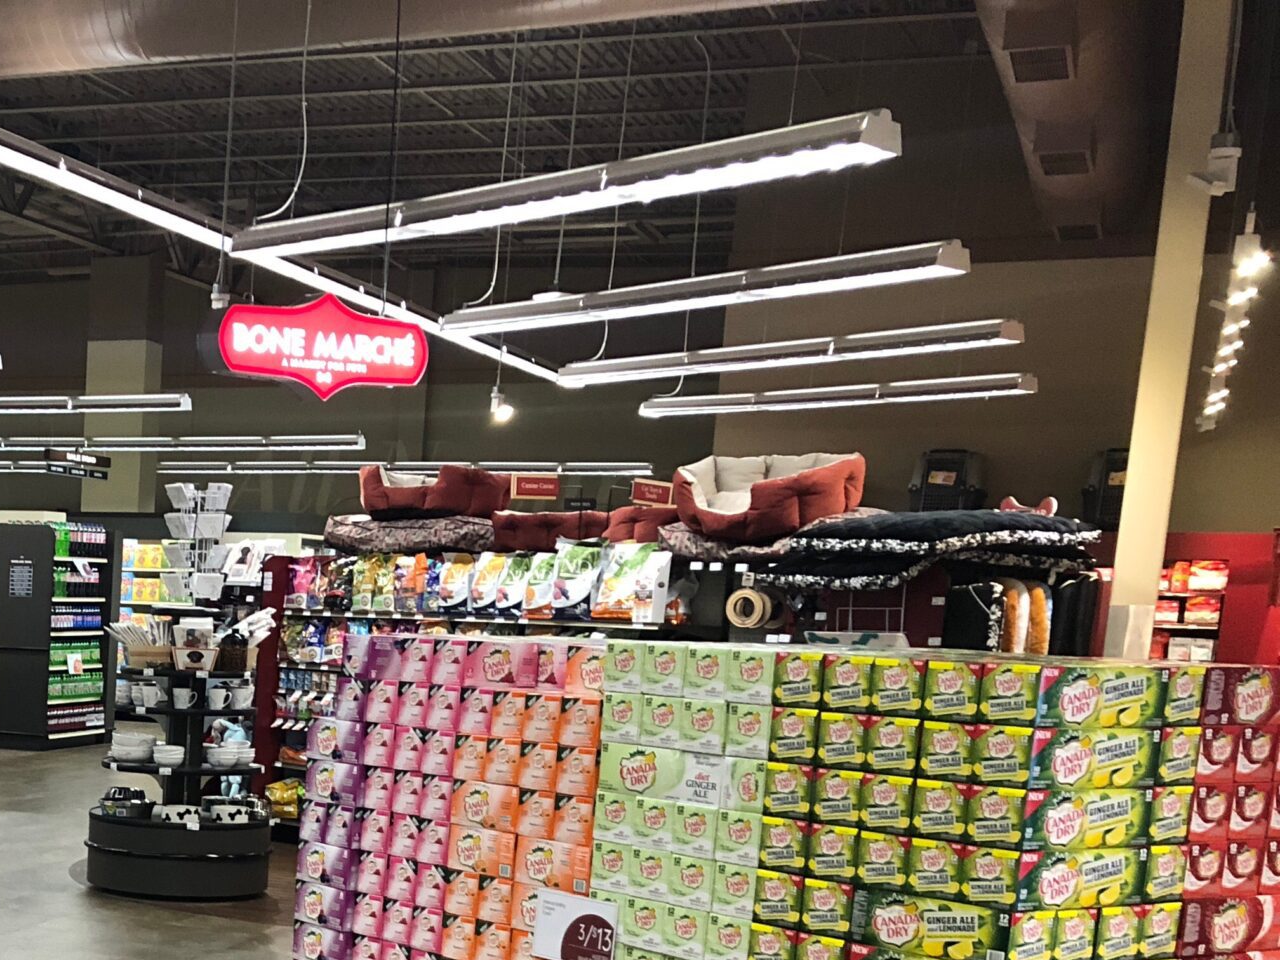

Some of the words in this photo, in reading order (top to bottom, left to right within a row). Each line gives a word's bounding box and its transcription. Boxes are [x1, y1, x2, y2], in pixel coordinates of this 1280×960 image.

[232, 322, 305, 357] BONE
[313, 331, 415, 367] MARCHÉ
[282, 358, 288, 367] A
[1105, 682, 1129, 695] GINGER
[1131, 679, 1144, 688] ALE
[1060, 687, 1101, 711] CANADA
[1071, 702, 1090, 717] DRY
[1245, 700, 1263, 716] DRY
[1098, 743, 1123, 756] GINGER
[1125, 739, 1136, 748] ALE
[1052, 747, 1093, 773] CANADA
[620, 762, 657, 780] CANADA
[695, 772, 710, 781] diet
[1064, 765, 1082, 778] DRY
[631, 775, 648, 786] DRY
[686, 780, 717, 790] GINGER
[693, 789, 708, 798] ALE
[1089, 804, 1115, 816] GINGER
[1117, 799, 1129, 809] ALE
[1045, 809, 1085, 833] CANADA
[1056, 825, 1075, 840] DRY
[1084, 864, 1110, 876] GINGER
[1111, 859, 1122, 868] ALE
[1040, 870, 1080, 895] CANADA
[1051, 885, 1069, 900] DRY
[873, 914, 923, 932] CANADA
[927, 916, 957, 925] GINGER
[959, 916, 976, 925] ALE
[578, 924, 612, 952] 3/$13
[887, 927, 910, 938] DRY
[1221, 931, 1240, 945] DRY
